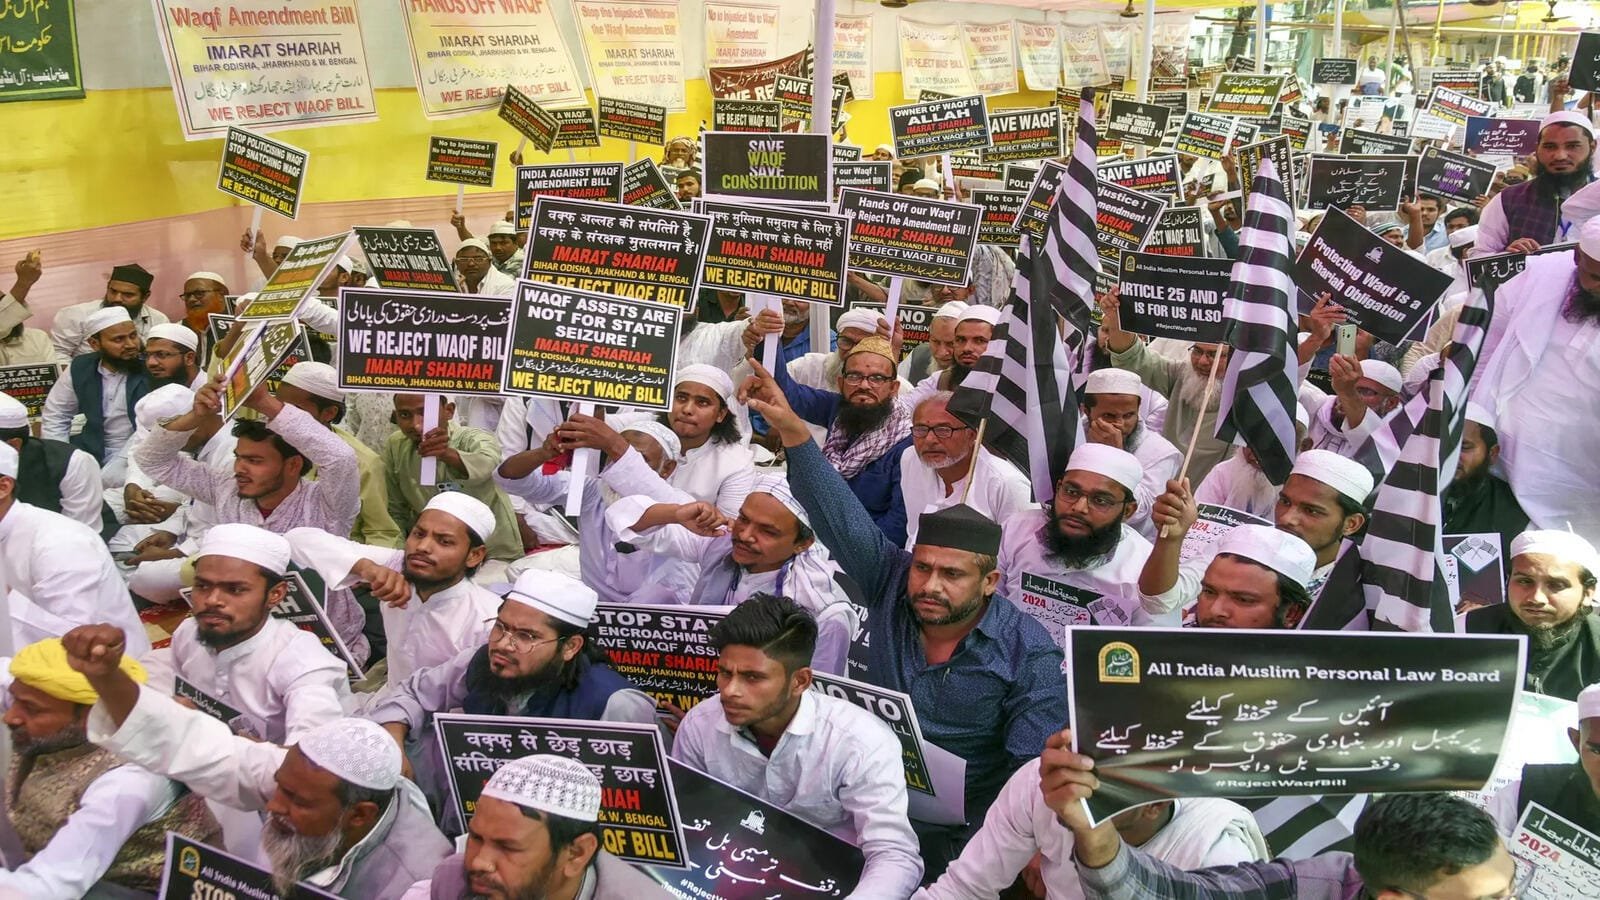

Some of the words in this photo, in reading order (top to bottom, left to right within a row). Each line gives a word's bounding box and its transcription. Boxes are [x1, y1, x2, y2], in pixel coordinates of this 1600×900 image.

[170, 7, 222, 32] Waqf
[229, 8, 327, 27] Amendment
[330, 5, 355, 24] Bill
[207, 44, 271, 60] IMARAT
[277, 42, 342, 57] SHARIAH
[439, 35, 486, 47] IMARAT
[488, 34, 540, 45] SHARIAH
[208, 107, 233, 121] WE
[237, 103, 292, 119] REJECT
[295, 99, 333, 115] WAQF
[338, 97, 364, 110] BILL
[895, 106, 928, 117] OWNER
[943, 101, 969, 111] WAQF
[970, 99, 979, 107] IS
[1437, 90, 1461, 104] SAVE
[1461, 98, 1488, 113] WAQF
[716, 113, 726, 124] WE
[727, 114, 747, 125] REJECT
[749, 114, 764, 128] WAQF
[766, 116, 778, 127] BILL
[908, 109, 970, 125] ALLAH
[991, 117, 1018, 133] AVE
[1023, 111, 1057, 130] WAQF
[230, 131, 246, 144] STOP
[247, 137, 285, 159] POLITICISING
[286, 150, 304, 164] WAQF
[450, 149, 461, 157] Waqf
[462, 150, 491, 158] Amendment
[458, 139, 485, 150] Injustice
[749, 140, 784, 151] SAVE
[229, 143, 246, 156] STOP
[246, 150, 281, 170] SNATCHING
[282, 162, 300, 177] WAQF
[748, 152, 786, 168] WAQF
[1098, 165, 1132, 181] SAVE
[1134, 160, 1174, 177] WAQF
[521, 169, 547, 179] INDIA
[550, 168, 591, 178] AGAINST
[593, 167, 618, 177] WAQF
[722, 175, 818, 190] CONSTITUTION
[749, 166, 784, 177] SAVE
[528, 180, 588, 189] AMENDMENT
[591, 178, 611, 186] BILL
[858, 197, 889, 211] Hands
[892, 201, 909, 213] Off
[911, 206, 927, 216] our
[929, 206, 954, 221] Waqf
[956, 211, 961, 220] !
[619, 215, 635, 231] की
[683, 221, 693, 236] है
[858, 210, 886, 224] Reject
[886, 214, 901, 226] The
[902, 216, 952, 233] Amendment
[953, 224, 966, 234] Bill
[967, 226, 971, 235] !
[572, 227, 583, 241] के
[587, 231, 626, 246] संरक्षक
[629, 238, 682, 253] मुसलमान
[715, 227, 738, 238] राज्य
[740, 227, 748, 239] के
[751, 230, 779, 243] शोषण
[782, 234, 791, 246] के
[794, 234, 812, 250] लिए
[815, 239, 833, 251] नहीं
[706, 267, 723, 283] WE
[727, 270, 771, 290] REJECT
[774, 275, 808, 296] WAQF
[811, 280, 837, 300] BILL
[1313, 237, 1363, 280] Protecting
[1362, 272, 1398, 299] Waqf
[1395, 291, 1410, 304] is
[1410, 300, 1422, 310] a
[1120, 281, 1165, 299] ARTICLE
[1167, 288, 1186, 301] 25
[1189, 290, 1218, 305] AND
[1311, 258, 1344, 292] Shariah
[1344, 286, 1406, 323] Obligation
[524, 289, 572, 307] WAQF
[576, 298, 638, 318] ASSETS
[642, 309, 674, 324] ARE
[1134, 301, 1145, 315] IS
[1148, 303, 1169, 318] FOR
[1172, 307, 1187, 320] US
[1191, 308, 1222, 323] ALSO
[528, 306, 566, 322] NOT
[571, 312, 606, 329] FOR
[612, 319, 665, 337] STATE
[348, 329, 372, 354] WE
[376, 330, 432, 357] REJECT
[437, 334, 478, 361] WAQF
[482, 336, 505, 361] BIL
[555, 326, 627, 346] SEIZURE
[632, 336, 637, 348] !
[534, 338, 589, 355] IMARAT
[591, 346, 652, 364] SHARIAH
[365, 358, 423, 376] IMARAT
[426, 361, 494, 380] SHARIAH
[512, 371, 535, 389] WE
[537, 375, 592, 395] REJECT
[594, 382, 632, 401] WAQF
[635, 385, 664, 404] BILL
[1022, 593, 1046, 609] 2024
[1147, 663, 1173, 675] All
[1177, 664, 1225, 677] India
[1230, 665, 1302, 679] Muslim
[1305, 666, 1390, 681] Personal
[1395, 669, 1436, 681] Law
[1442, 669, 1500, 682] Board
[1185, 693, 1235, 726] کیلئے
[1233, 700, 1278, 721] تحفظ
[1285, 699, 1329, 722] کے
[1339, 695, 1394, 726] آئین
[518, 729, 538, 750] से
[545, 731, 582, 757] छेड़
[587, 738, 633, 760] छाड़
[1096, 723, 1142, 754] کیلئے
[1142, 730, 1184, 750] تحفظ
[1193, 730, 1233, 750] کے
[1242, 731, 1297, 752] حقوق
[1306, 732, 1364, 755] بنیادی
[1378, 736, 1403, 749] اور
[1168, 759, 1184, 773] لو
[1192, 754, 1270, 775] واپس
[1279, 758, 1308, 774] بل
[1316, 756, 1400, 772] وقف
[1216, 780, 1347, 788] #RejectWaqfBill
[1518, 833, 1561, 863] 2024
